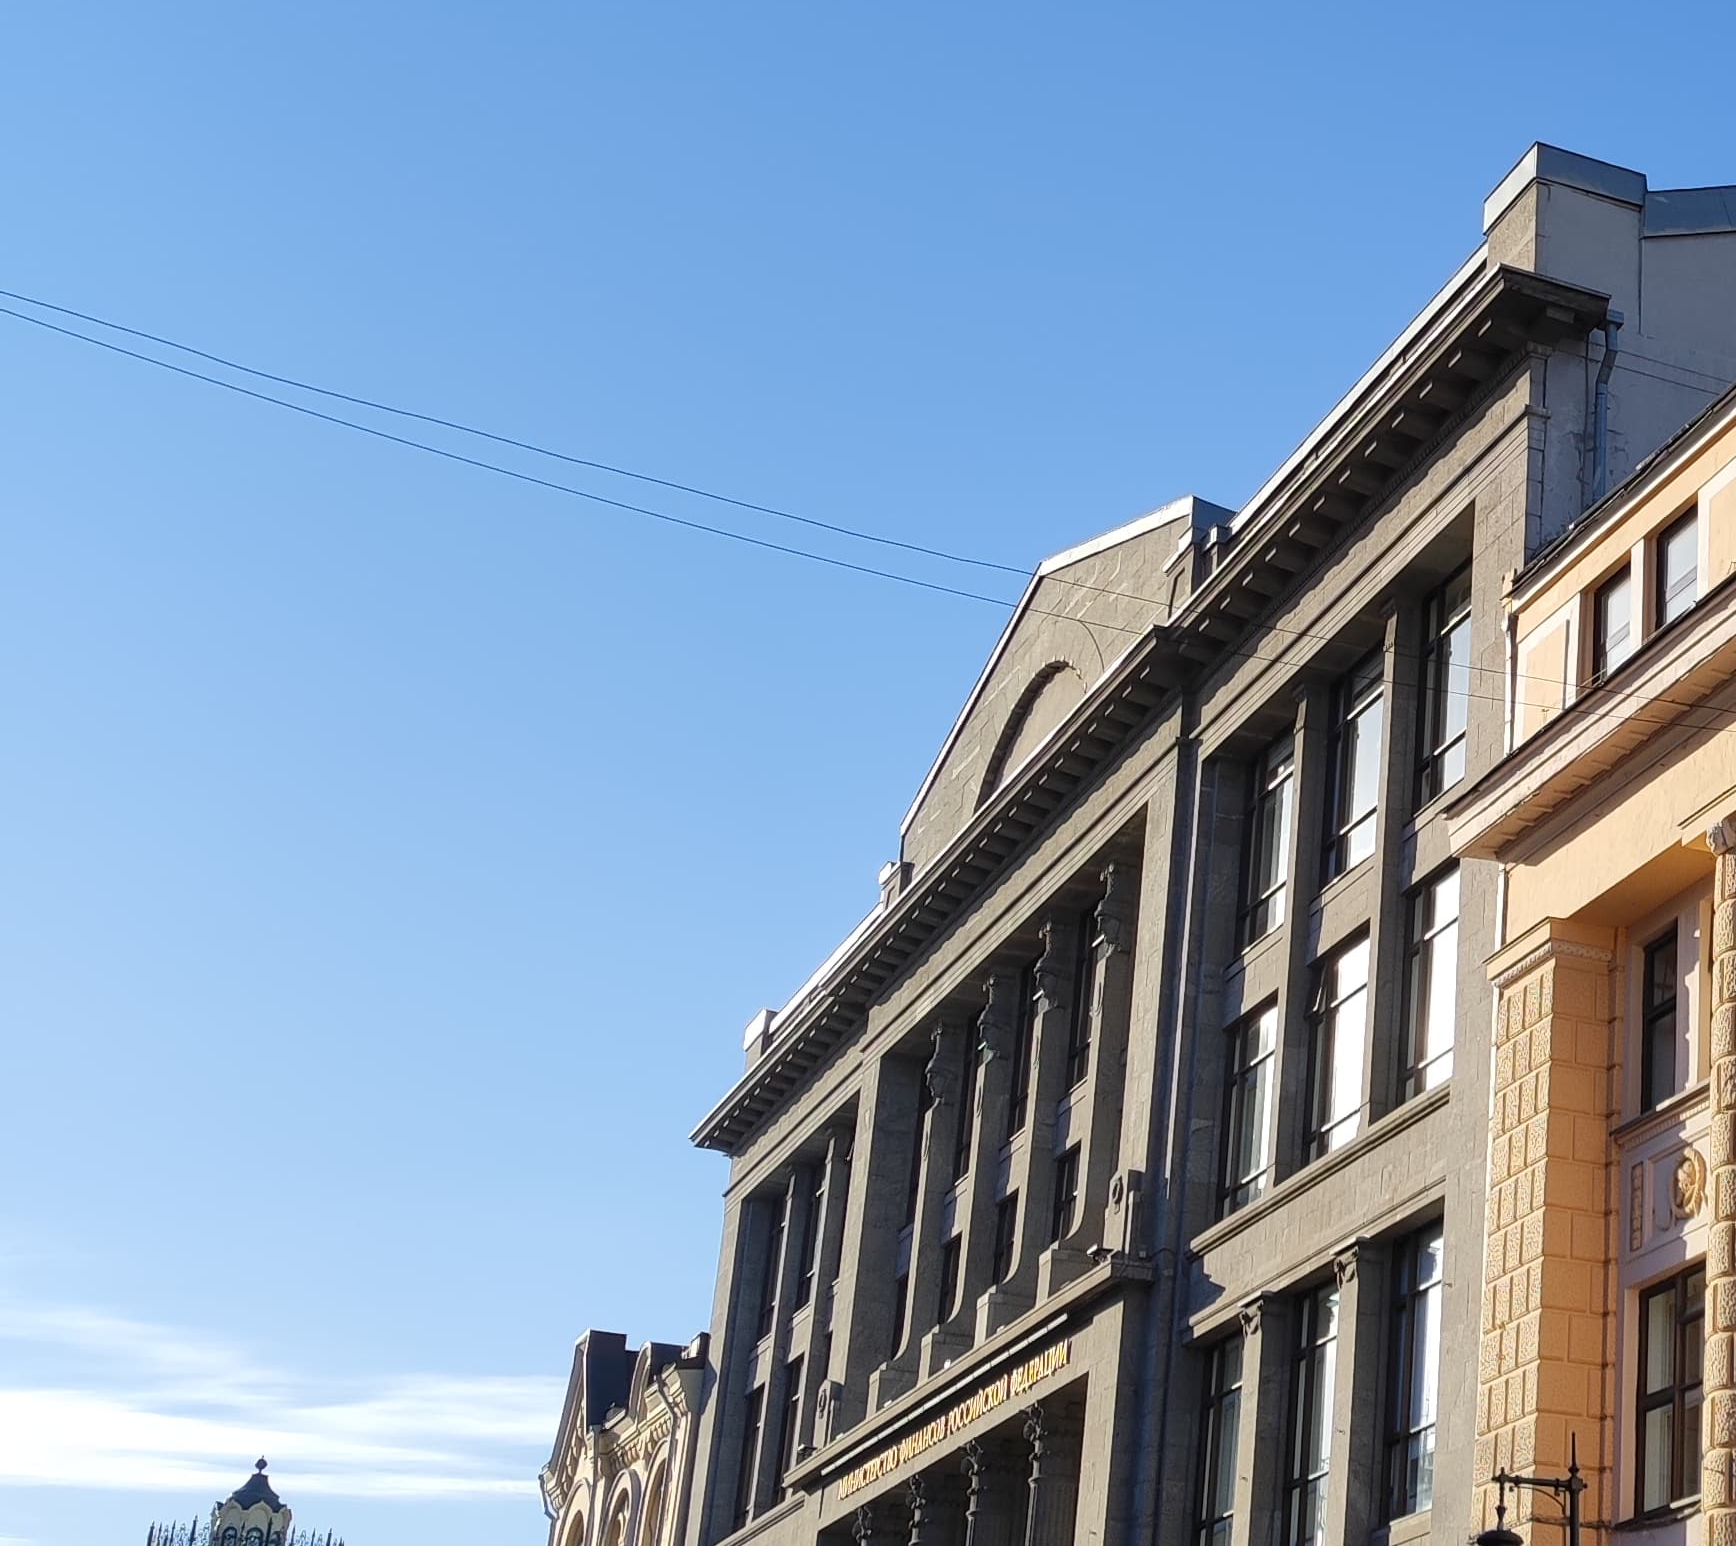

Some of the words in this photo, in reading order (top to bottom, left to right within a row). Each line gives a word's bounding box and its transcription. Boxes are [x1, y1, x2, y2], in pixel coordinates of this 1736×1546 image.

[837, 1445, 899, 1501] МИНИСТЕРСТВО
[899, 1416, 946, 1464] ФИНАНСОВ
[947, 1373, 1009, 1436] РОССИЙСКОЙ
[1009, 1338, 1070, 1397] ФЕДЕРАЦИИ
